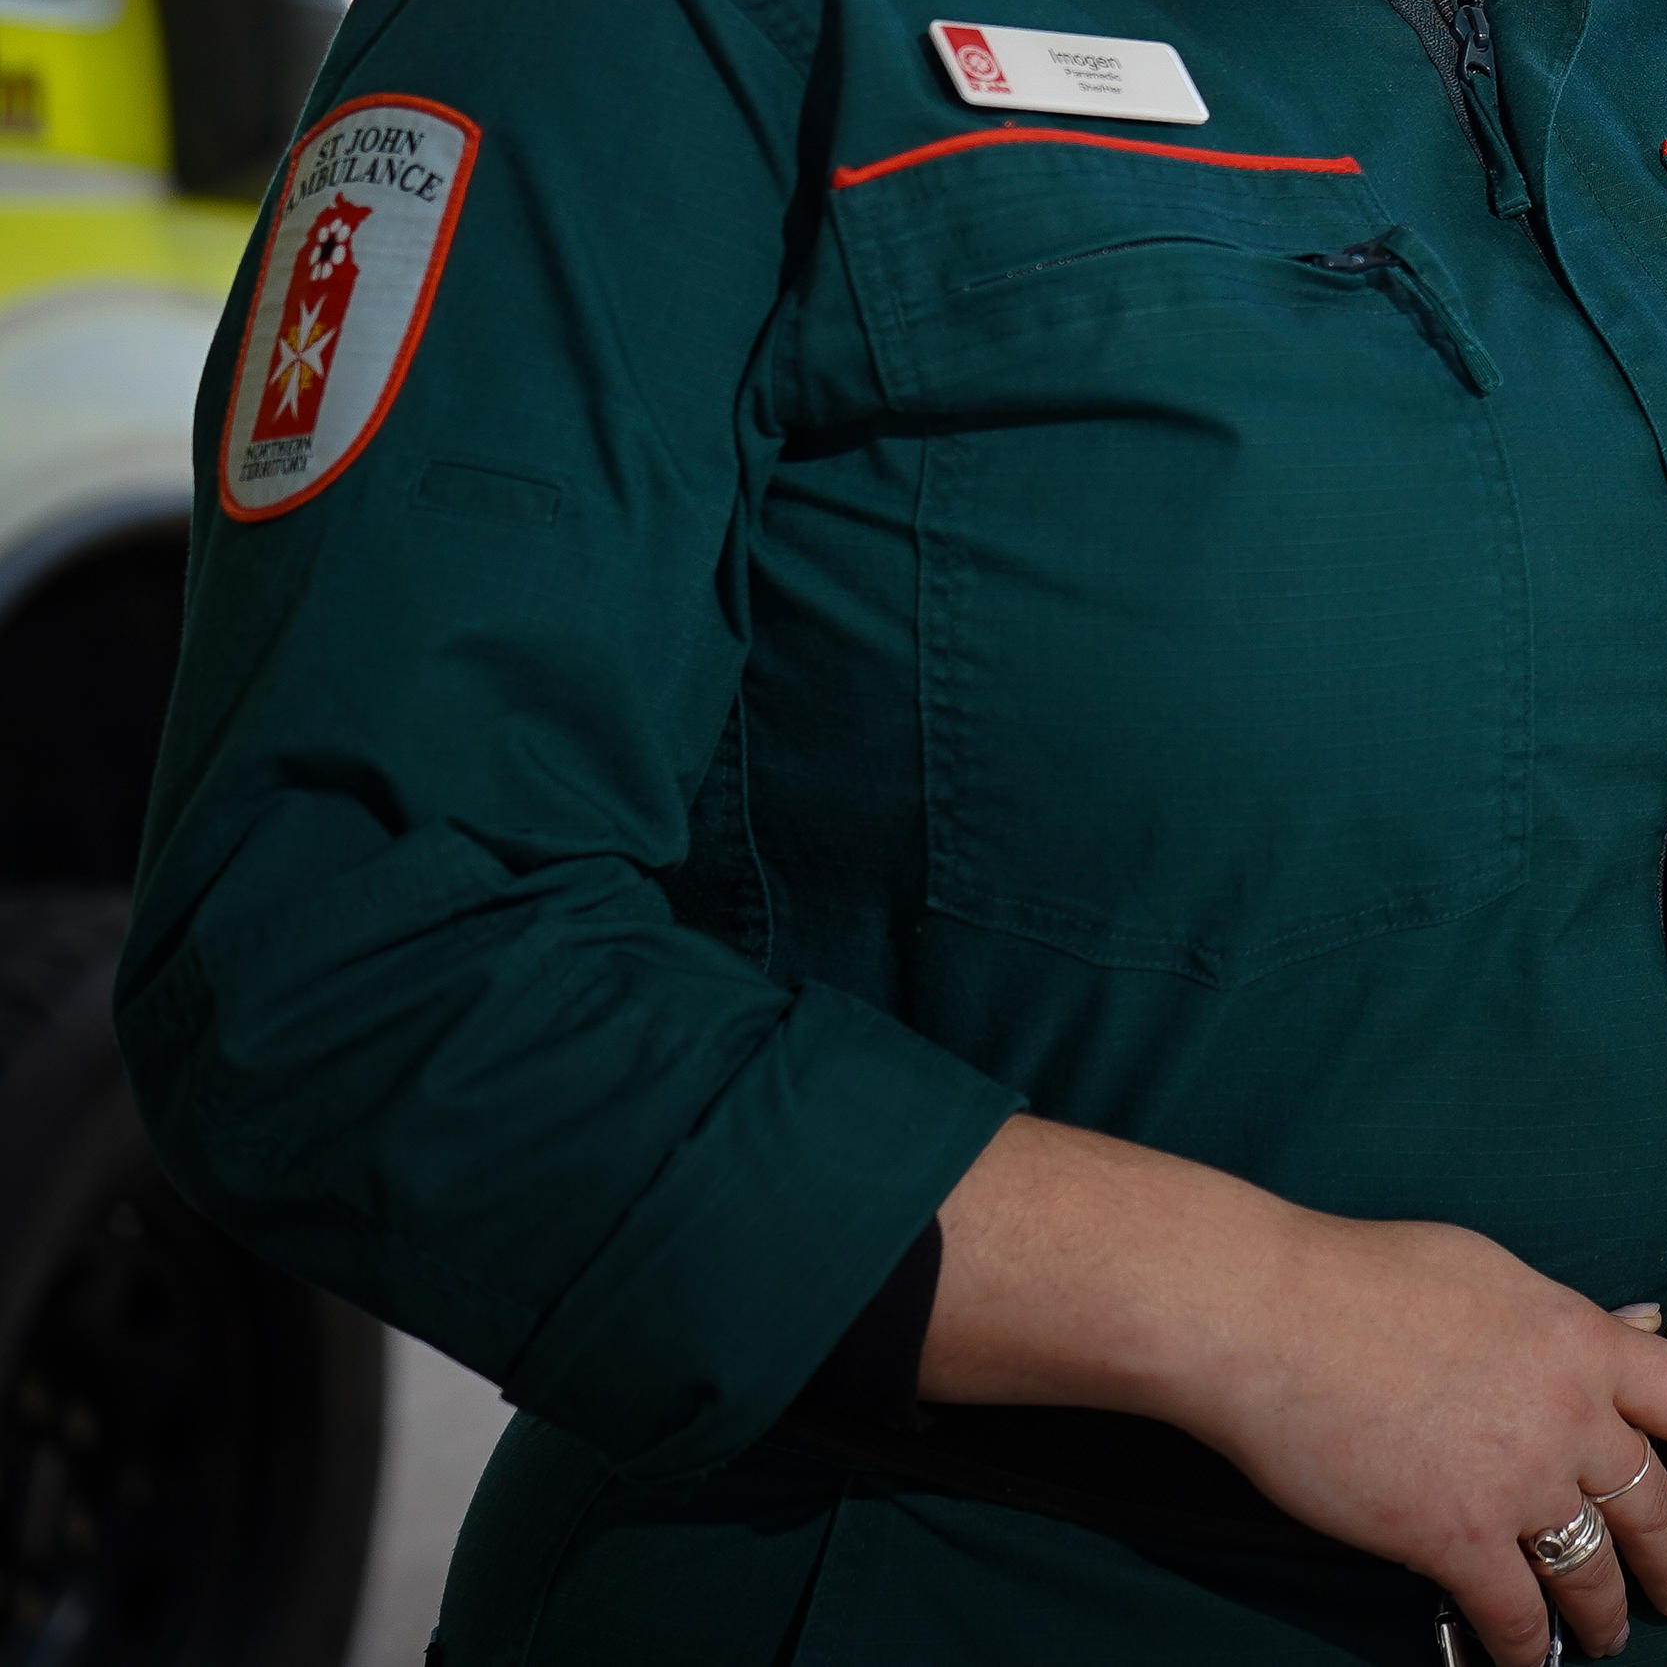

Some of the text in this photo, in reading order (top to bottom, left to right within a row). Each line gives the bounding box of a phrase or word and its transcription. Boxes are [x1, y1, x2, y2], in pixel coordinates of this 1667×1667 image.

[1047, 47, 1122, 71] Imogen
[315, 127, 424, 167] ST JOHN
[283, 156, 445, 216] AMBULANCE
